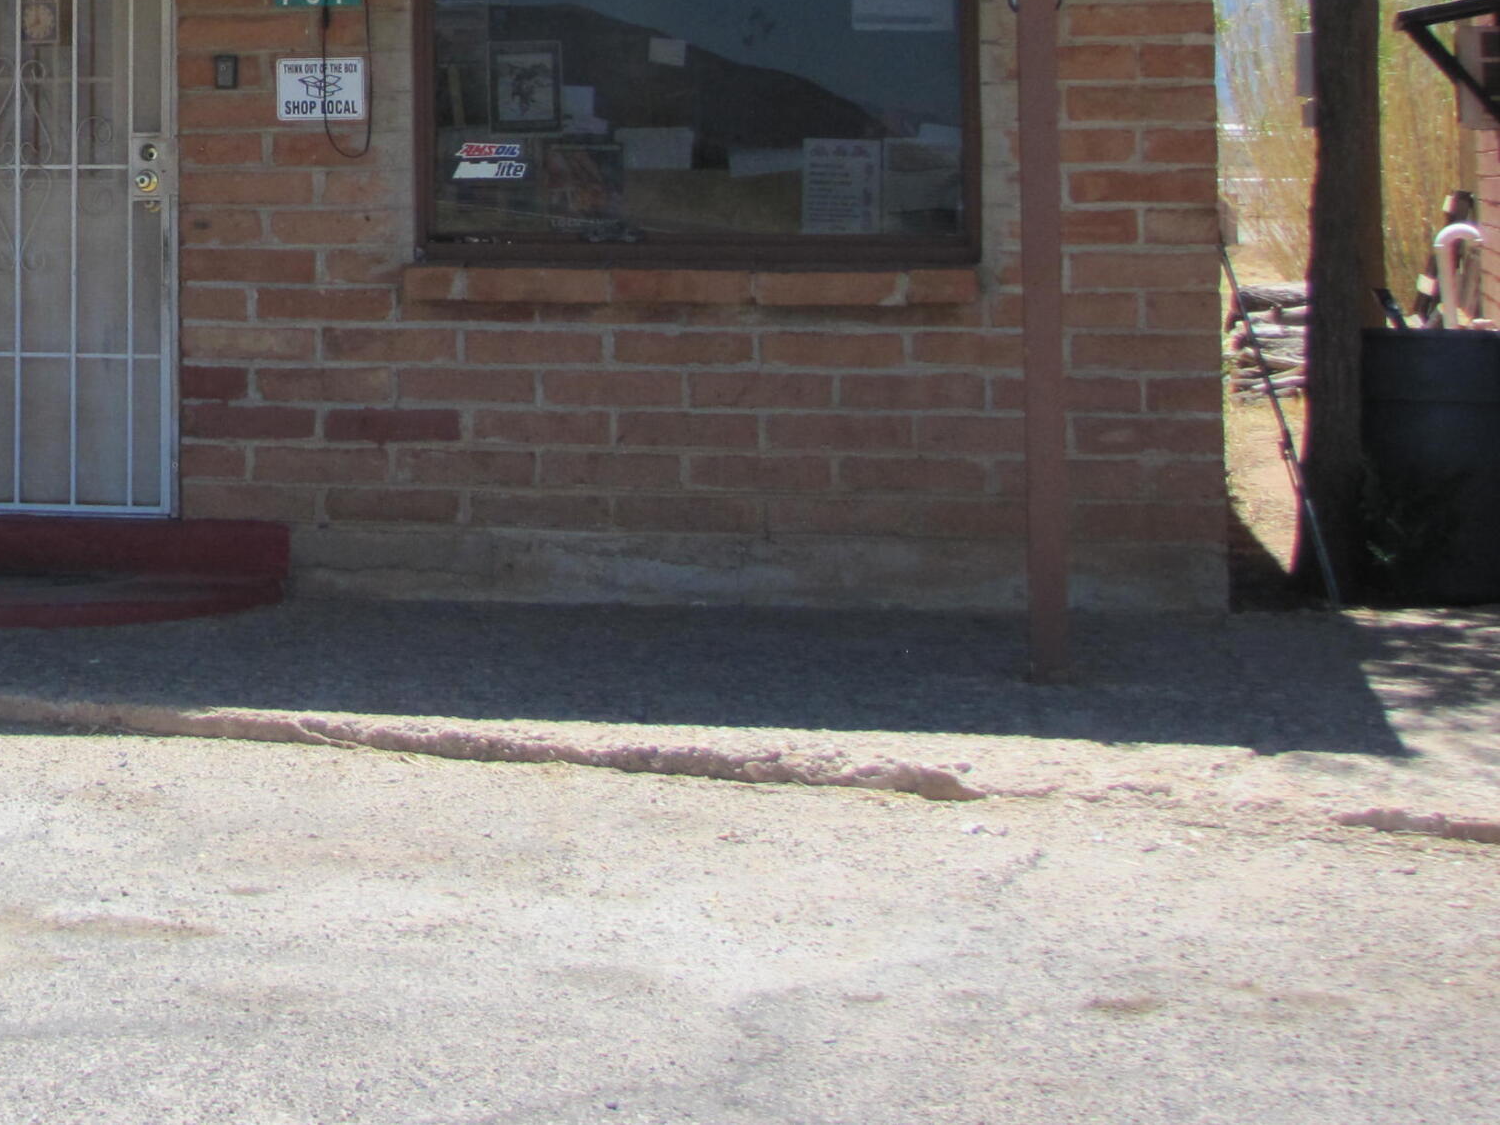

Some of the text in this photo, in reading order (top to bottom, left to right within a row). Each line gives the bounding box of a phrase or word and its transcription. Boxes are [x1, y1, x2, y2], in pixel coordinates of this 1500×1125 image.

[283, 63, 303, 74] THINK
[304, 63, 318, 74] OUT
[330, 62, 342, 73] THE
[343, 62, 357, 73] BOX
[284, 99, 358, 115] SHOP LOCAL
[458, 144, 519, 157] AMSOIL
